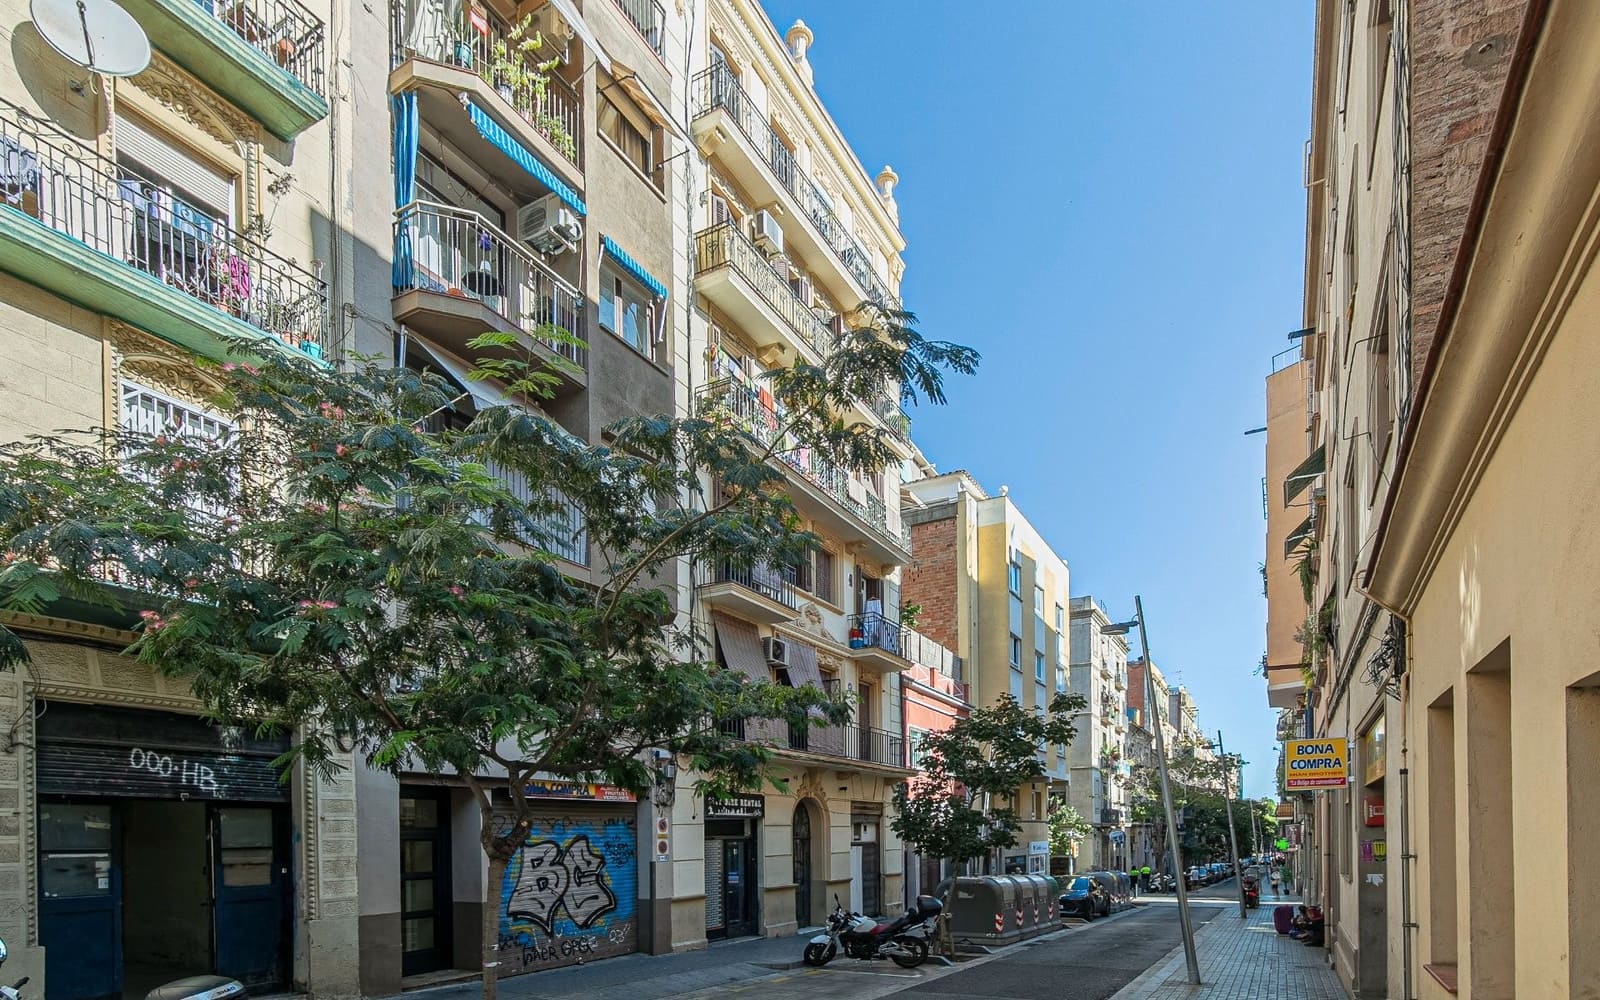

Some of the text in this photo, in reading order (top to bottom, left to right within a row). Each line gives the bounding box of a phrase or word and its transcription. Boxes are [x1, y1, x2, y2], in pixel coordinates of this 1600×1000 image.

[1297, 743, 1334, 755] BONA
[1290, 757, 1342, 770] COMPRA
[740, 799, 762, 807] RENTAL
